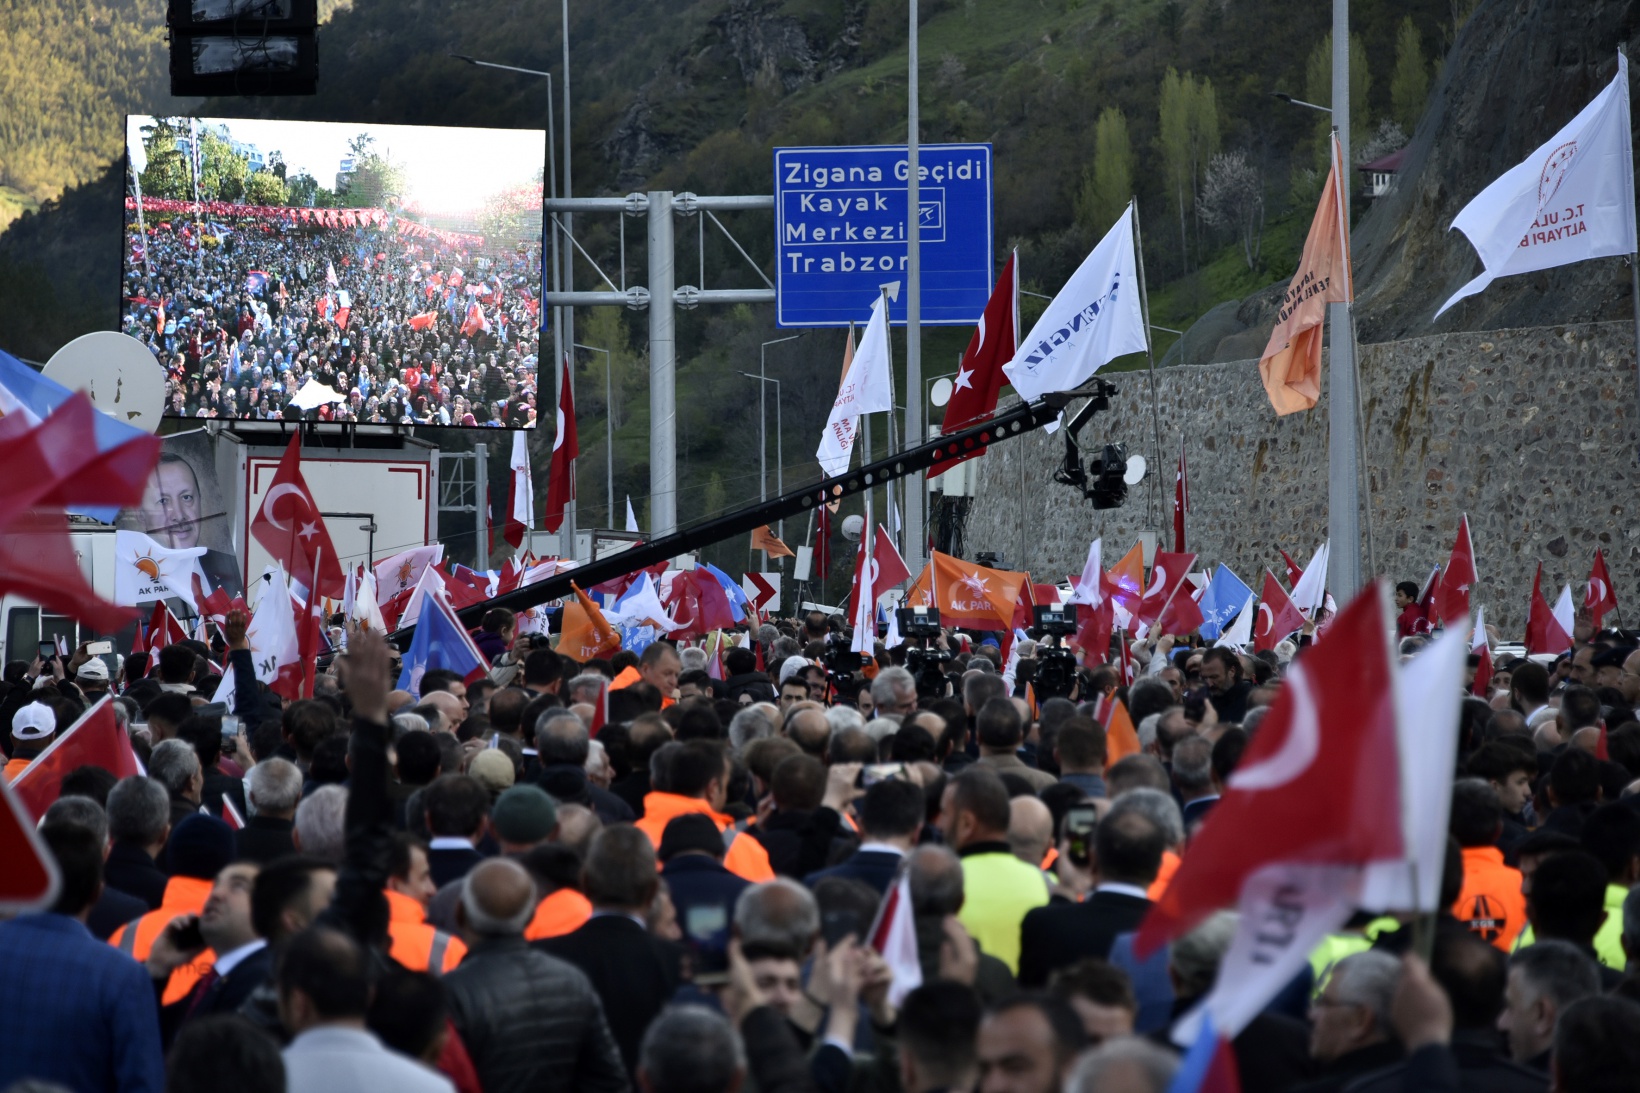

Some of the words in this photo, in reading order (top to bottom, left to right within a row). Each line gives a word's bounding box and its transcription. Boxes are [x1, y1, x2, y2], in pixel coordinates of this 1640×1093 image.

[785, 162, 882, 188] Zigana
[894, 159, 981, 183] Geçidi
[800, 192, 888, 216] Kayak
[786, 222, 904, 242] Merkezi
[832, 422, 849, 450] ANLIĞI
[951, 600, 966, 611] AK
